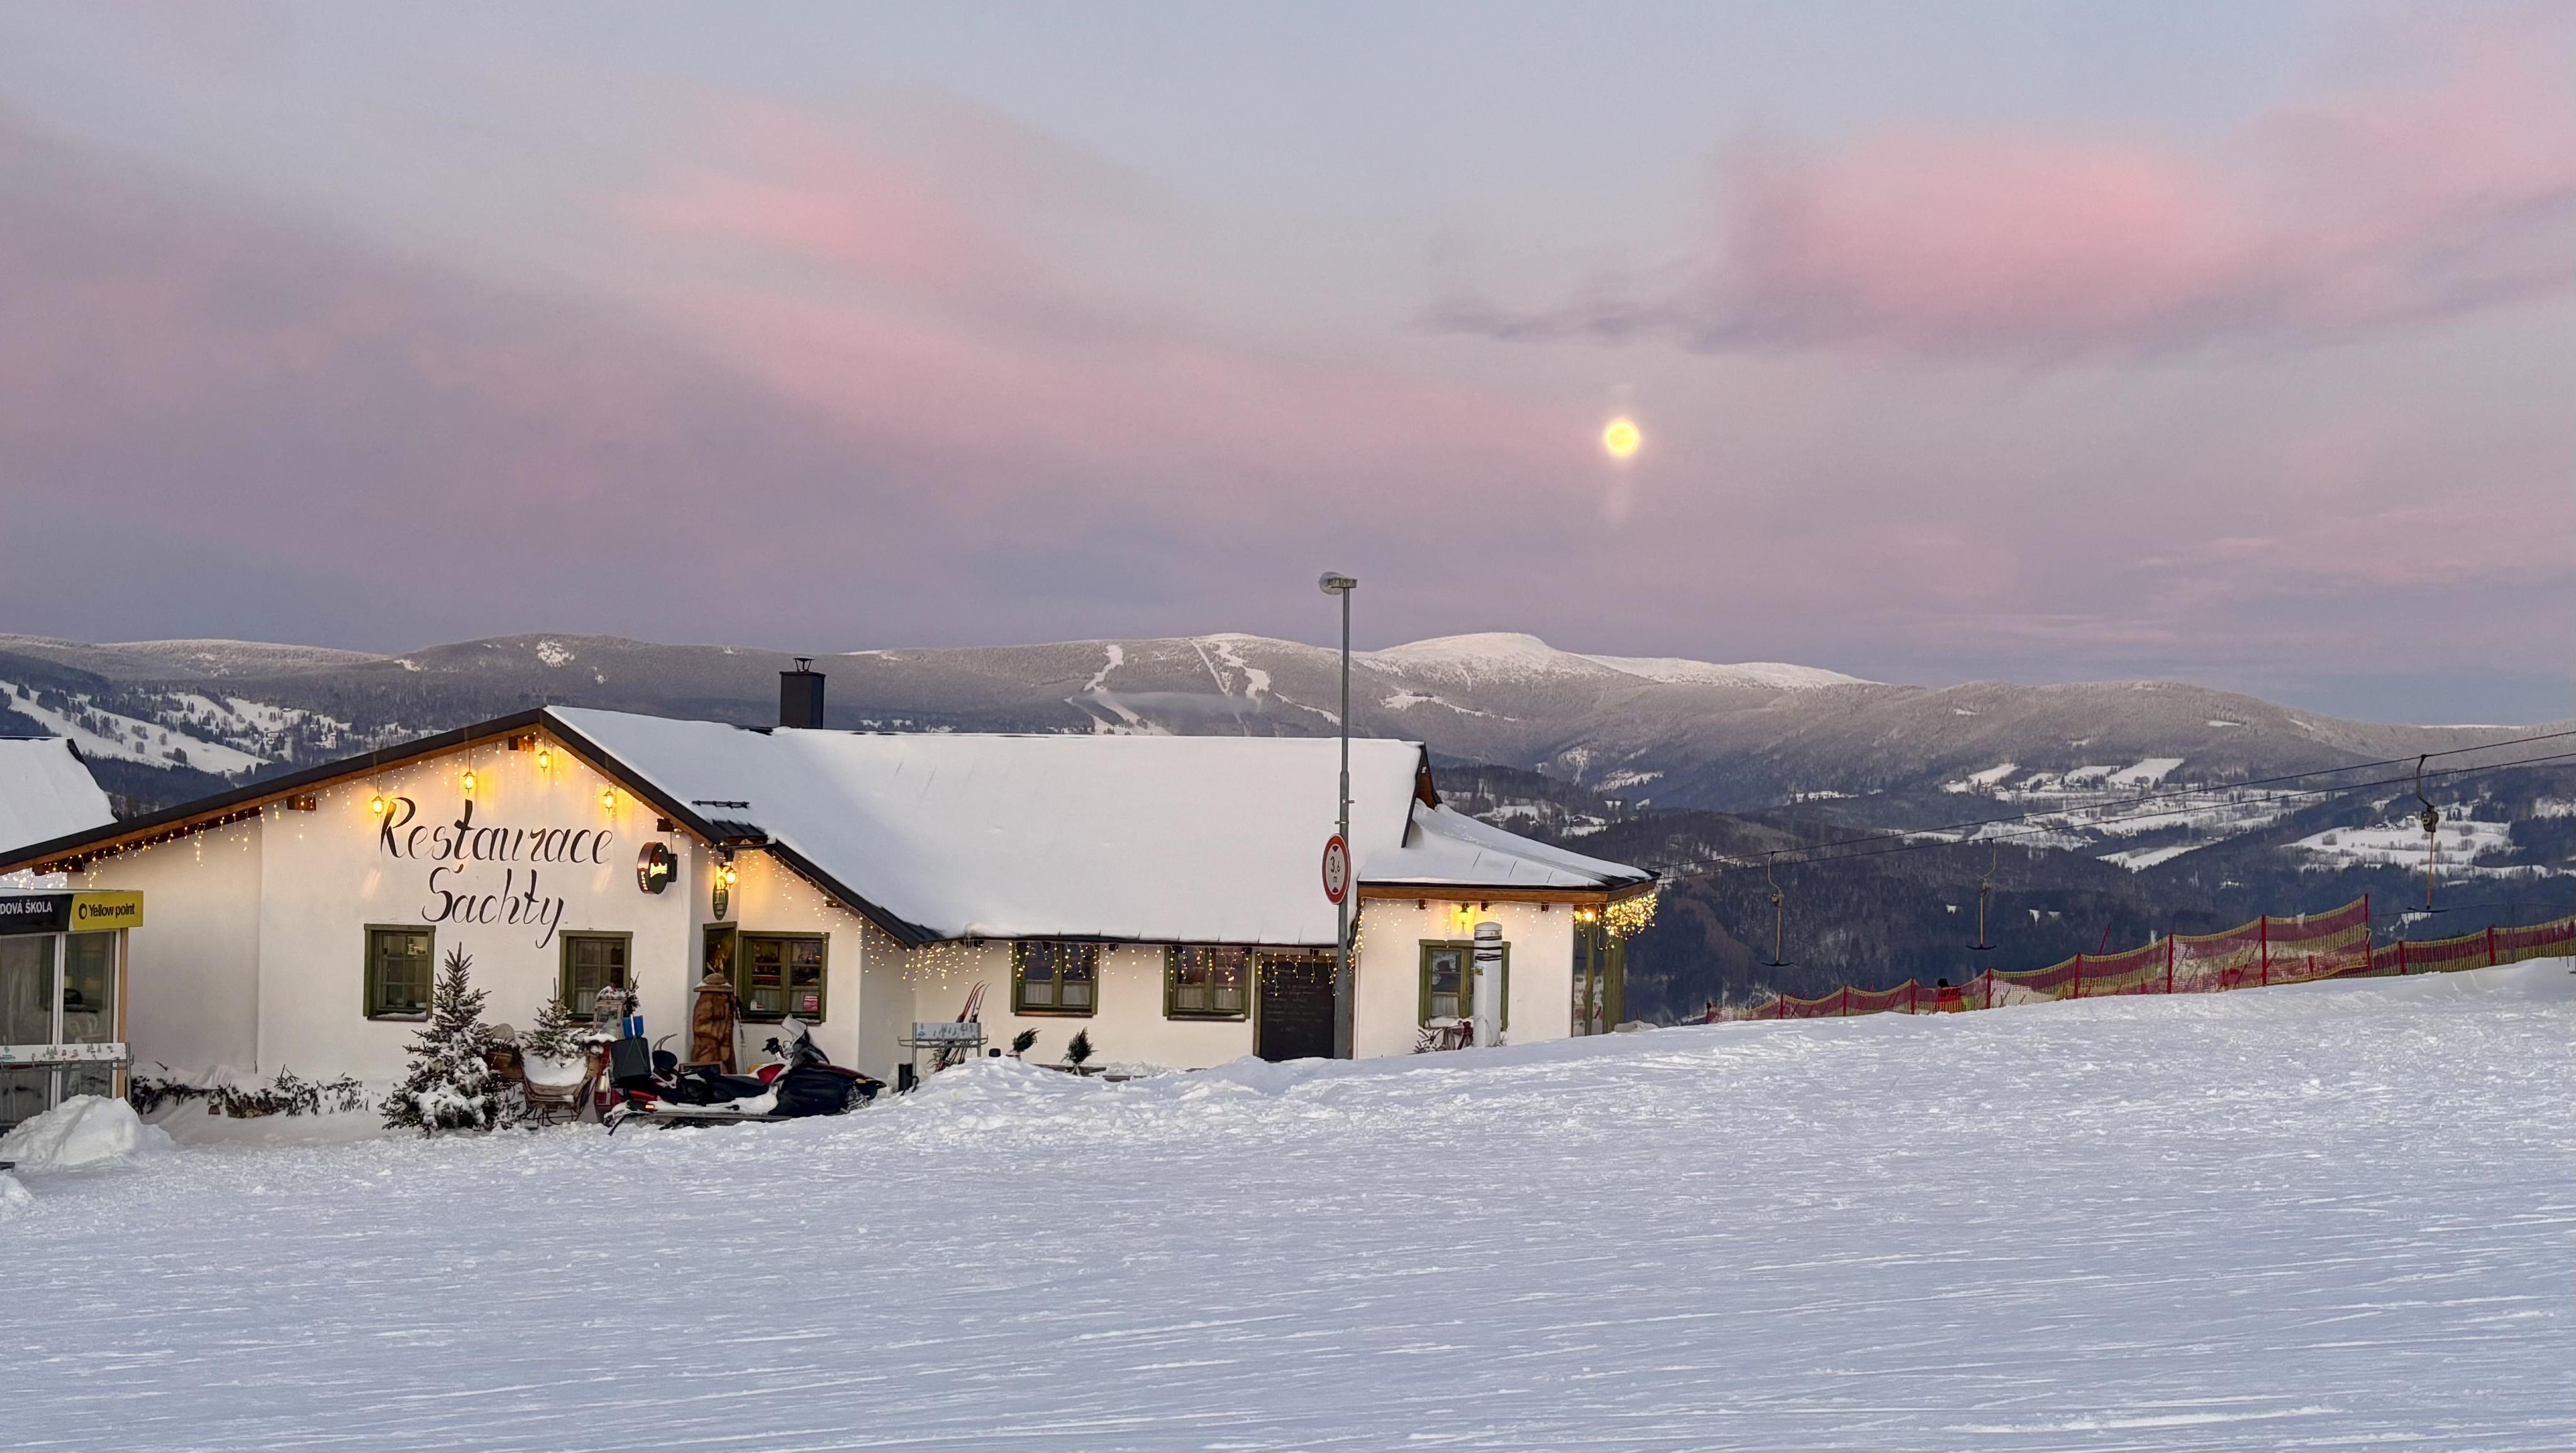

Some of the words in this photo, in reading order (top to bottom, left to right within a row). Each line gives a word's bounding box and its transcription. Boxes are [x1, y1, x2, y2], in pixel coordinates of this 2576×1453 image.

[380, 797, 613, 865] Restaurace
[25, 899, 53, 914] ŠKOLA
[89, 904, 114, 917] Yellow
[115, 903, 135, 919] point
[422, 864, 564, 949] Šachty
